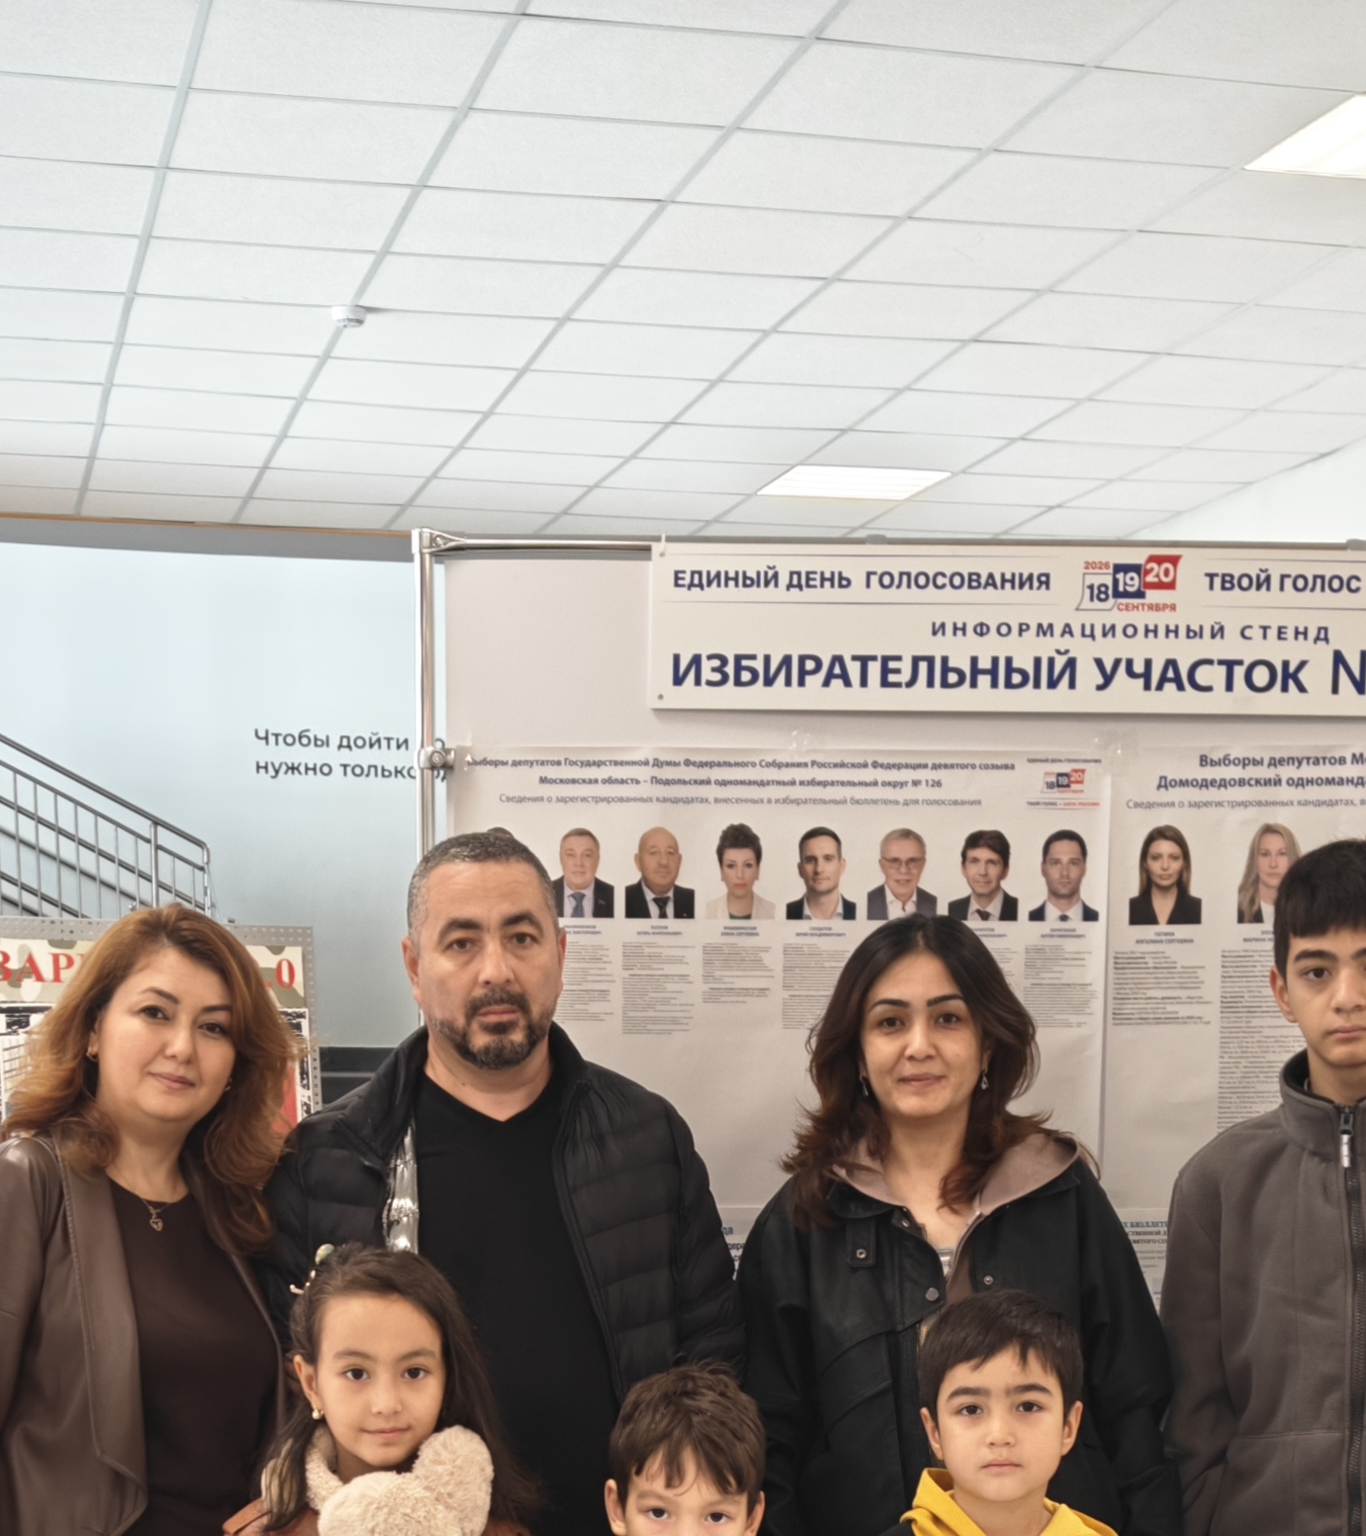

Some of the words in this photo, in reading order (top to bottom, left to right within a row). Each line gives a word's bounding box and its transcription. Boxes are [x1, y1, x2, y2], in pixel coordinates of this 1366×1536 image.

[1083, 561, 1111, 570] 2026
[1145, 562, 1175, 583] 20
[673, 565, 780, 592] ЕДИНЫЙ
[785, 570, 852, 592] ДЕНЬ
[865, 571, 1051, 591] ГОЛОСОВАНИЯ
[1115, 571, 1140, 592] 19
[1204, 568, 1272, 593] ТВОЙ
[1278, 573, 1362, 594] ГОЛОС
[1086, 583, 1110, 603] 18
[1116, 602, 1177, 612] СЕНТЯБРЯ
[931, 620, 1225, 642] ИНФОРМАЦИОННЫЙ
[1239, 624, 1331, 645] СТЕНД
[672, 649, 1078, 691] ИЗБИРАТЕЛЬНЫЙ
[1092, 656, 1310, 694] УЧАСТОК
[254, 728, 330, 749] Чтобы
[337, 731, 410, 751] дойти
[255, 760, 333, 780] нужно
[339, 763, 417, 780] только
[511, 759, 563, 769] депутатов
[563, 757, 651, 769] Государственной
[651, 757, 681, 769] Думы
[682, 758, 757, 770] Федерального
[759, 759, 809, 770] Собрания
[810, 759, 869, 771] Российской
[870, 760, 929, 771] Федерации
[930, 761, 977, 772] девятого
[978, 762, 1016, 771] созыва
[1198, 754, 1265, 768] Выборы
[1267, 755, 1347, 769] депутатов
[538, 775, 600, 786] Московская
[601, 775, 641, 786] область
[650, 775, 712, 788] Подольский
[713, 776, 797, 788] одномандатный
[798, 777, 879, 788] избирательный
[880, 779, 909, 789] округ
[924, 779, 943, 788] 126
[1045, 781, 1056, 790] 18
[1057, 776, 1069, 786] 19
[1156, 774, 1283, 791] Домодедовский
[1126, 799, 1176, 810] Сведения
